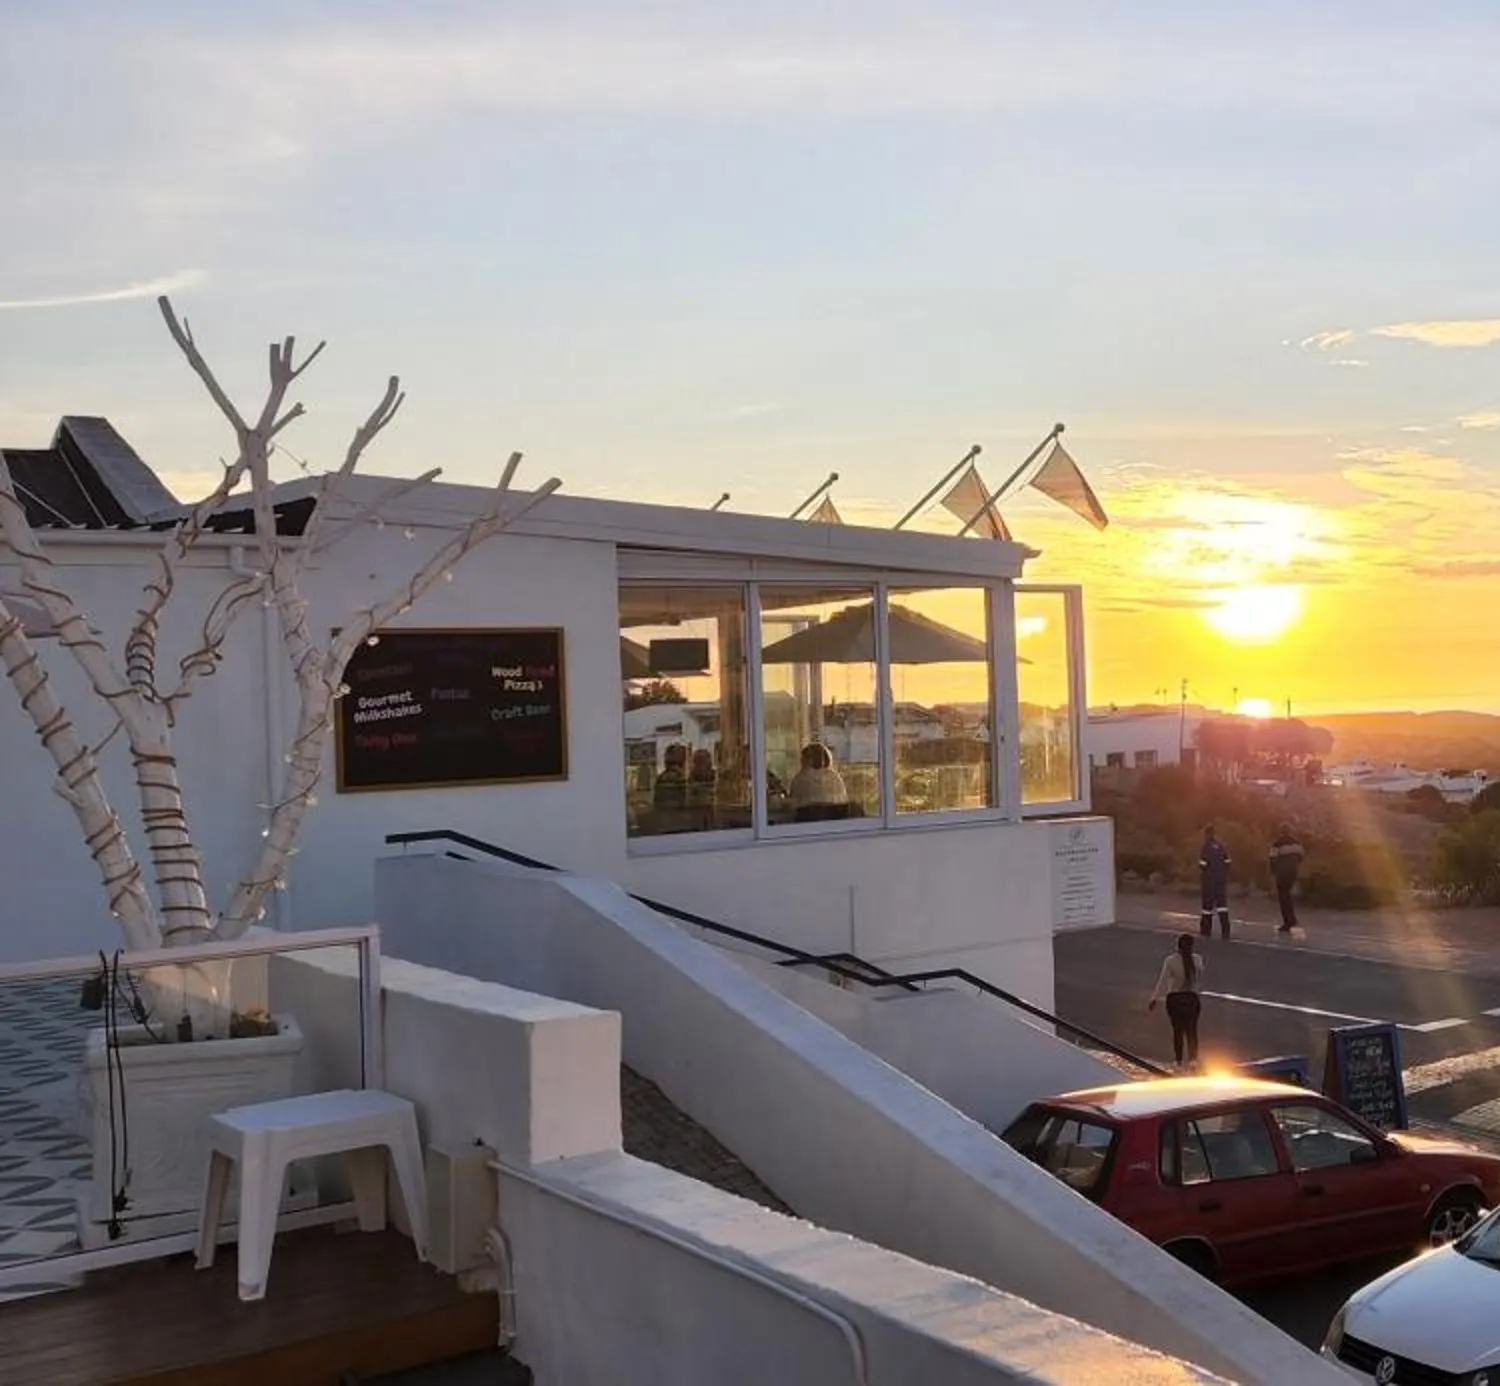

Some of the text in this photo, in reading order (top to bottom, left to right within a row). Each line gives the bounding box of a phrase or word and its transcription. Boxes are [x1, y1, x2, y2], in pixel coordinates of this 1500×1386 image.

[491, 665, 522, 677] Wood
[358, 691, 413, 709] Gourmet
[353, 704, 422, 724] Milkshakes
